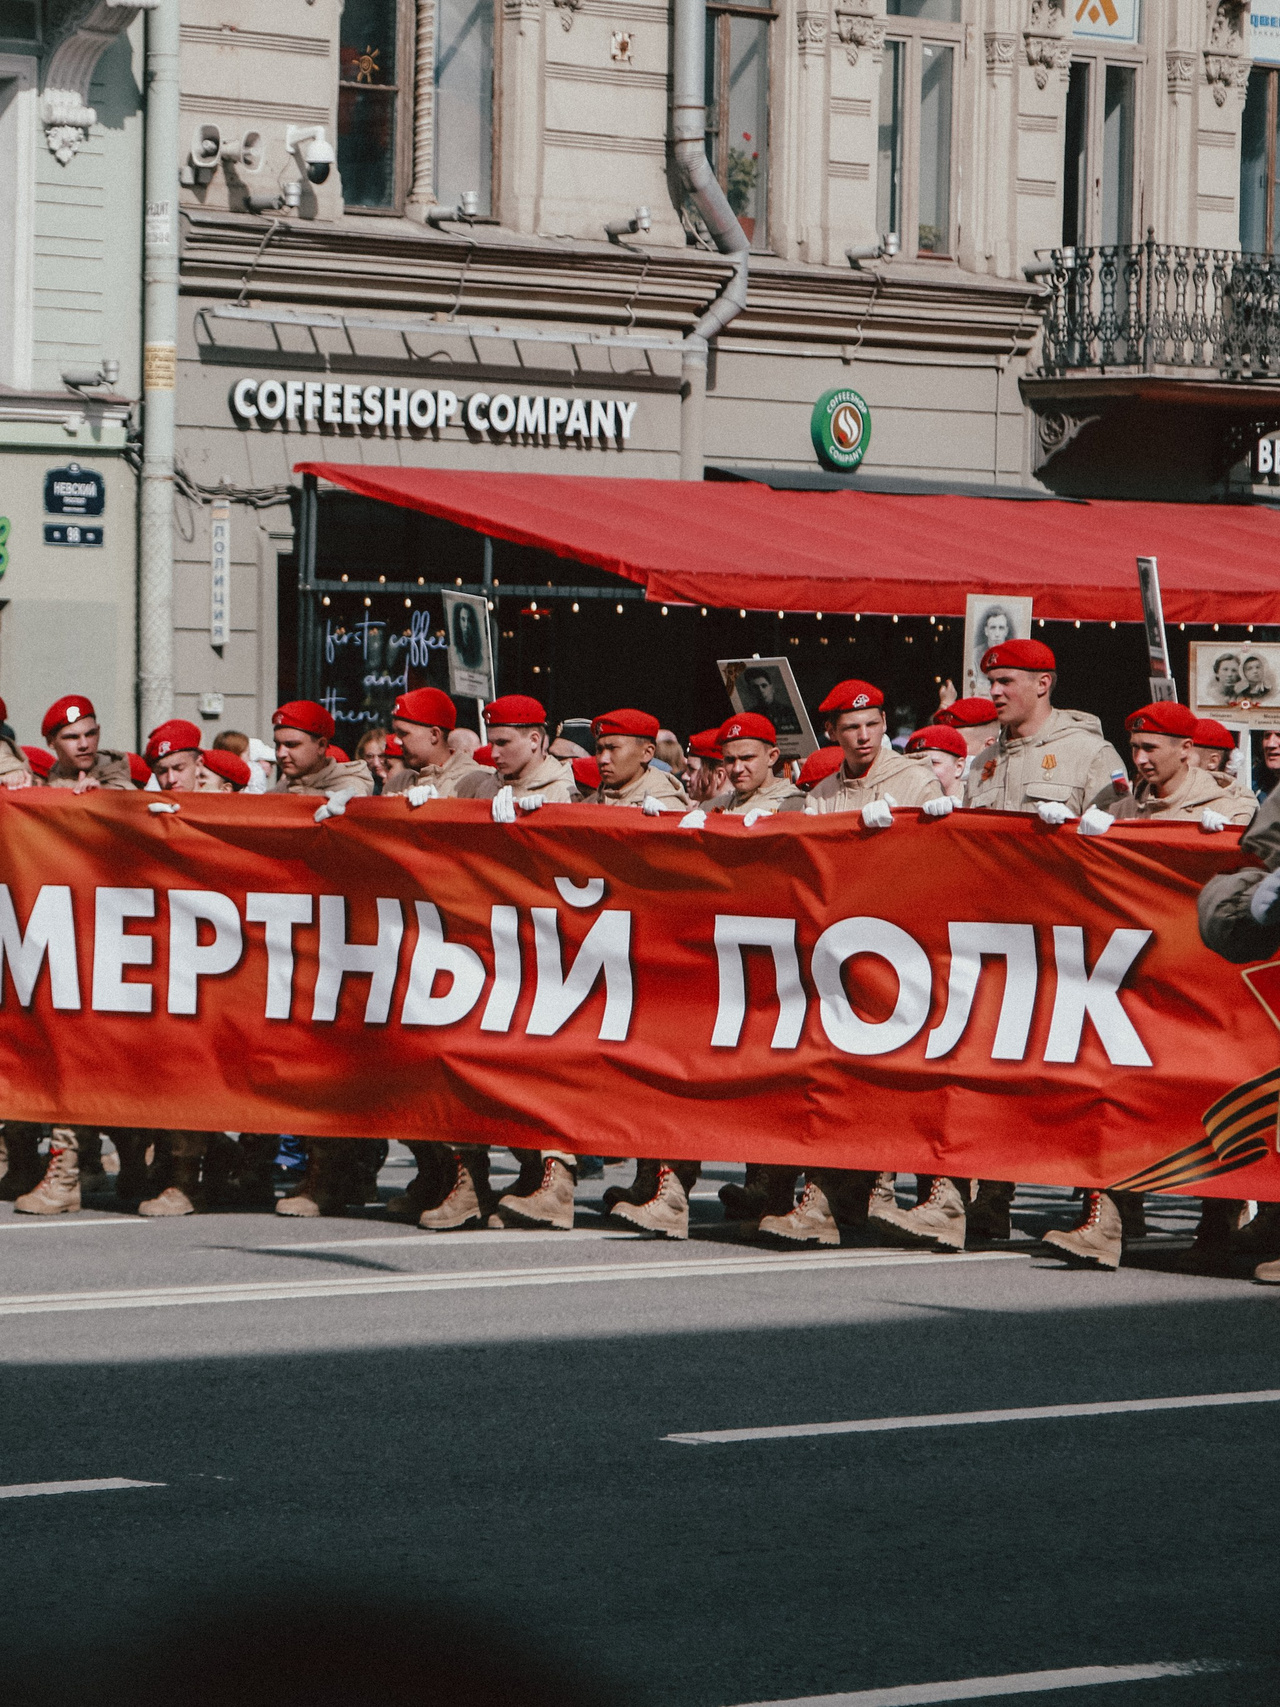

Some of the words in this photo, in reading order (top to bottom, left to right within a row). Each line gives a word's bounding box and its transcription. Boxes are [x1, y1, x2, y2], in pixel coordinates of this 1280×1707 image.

[234, 378, 458, 429] COFFEESHOP
[468, 392, 637, 439] COMPANY
[826, 391, 868, 413] COFFEESHOP
[829, 445, 863, 463] COMPANY
[53, 481, 98, 498] НЕВСКИЙ
[325, 610, 387, 665] first
[388, 610, 449, 668] coffee
[363, 653, 410, 694] and
[710, 914, 1154, 1068] ПОЛК
